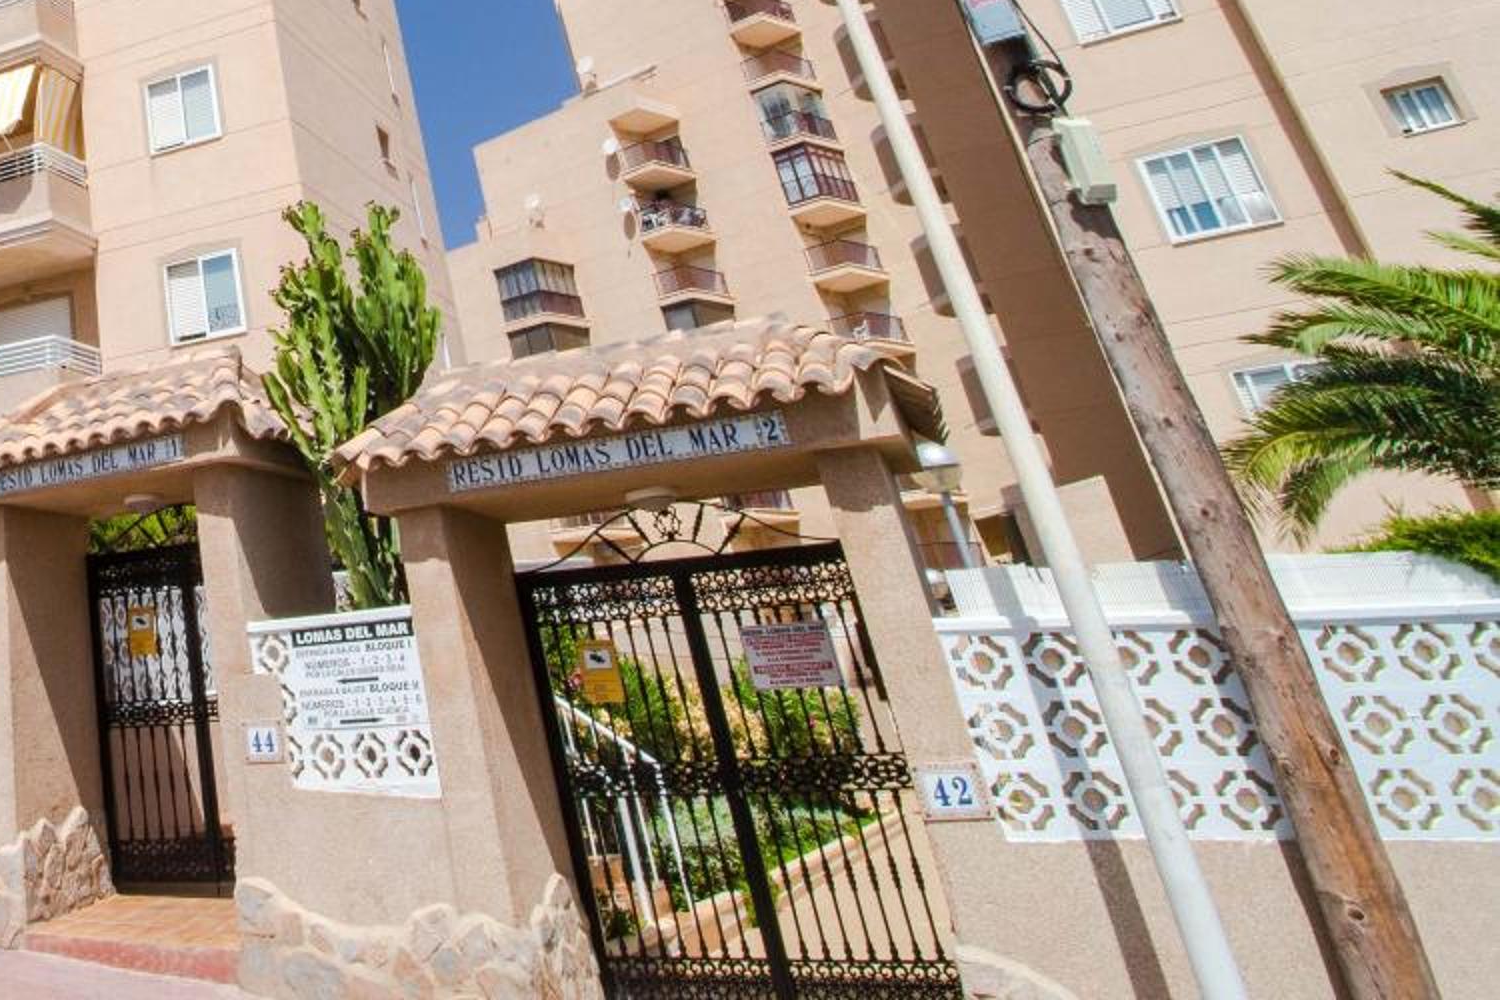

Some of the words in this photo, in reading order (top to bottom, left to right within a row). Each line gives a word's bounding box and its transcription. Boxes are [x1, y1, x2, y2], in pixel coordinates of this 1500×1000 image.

[41, 457, 85, 483] LOMAS
[92, 448, 118, 474] DEL
[128, 441, 156, 463] MAR
[453, 456, 523, 486] RESID
[538, 444, 611, 473] LOMAS
[626, 431, 674, 462] DEL
[689, 422, 739, 453] MAR
[762, 418, 779, 441] 2
[296, 628, 343, 645] LOMAS
[345, 625, 373, 640] DEL
[375, 622, 409, 636] MAR
[365, 640, 405, 652] BLOQUE
[252, 730, 275, 753] 44
[934, 775, 973, 807] 42
